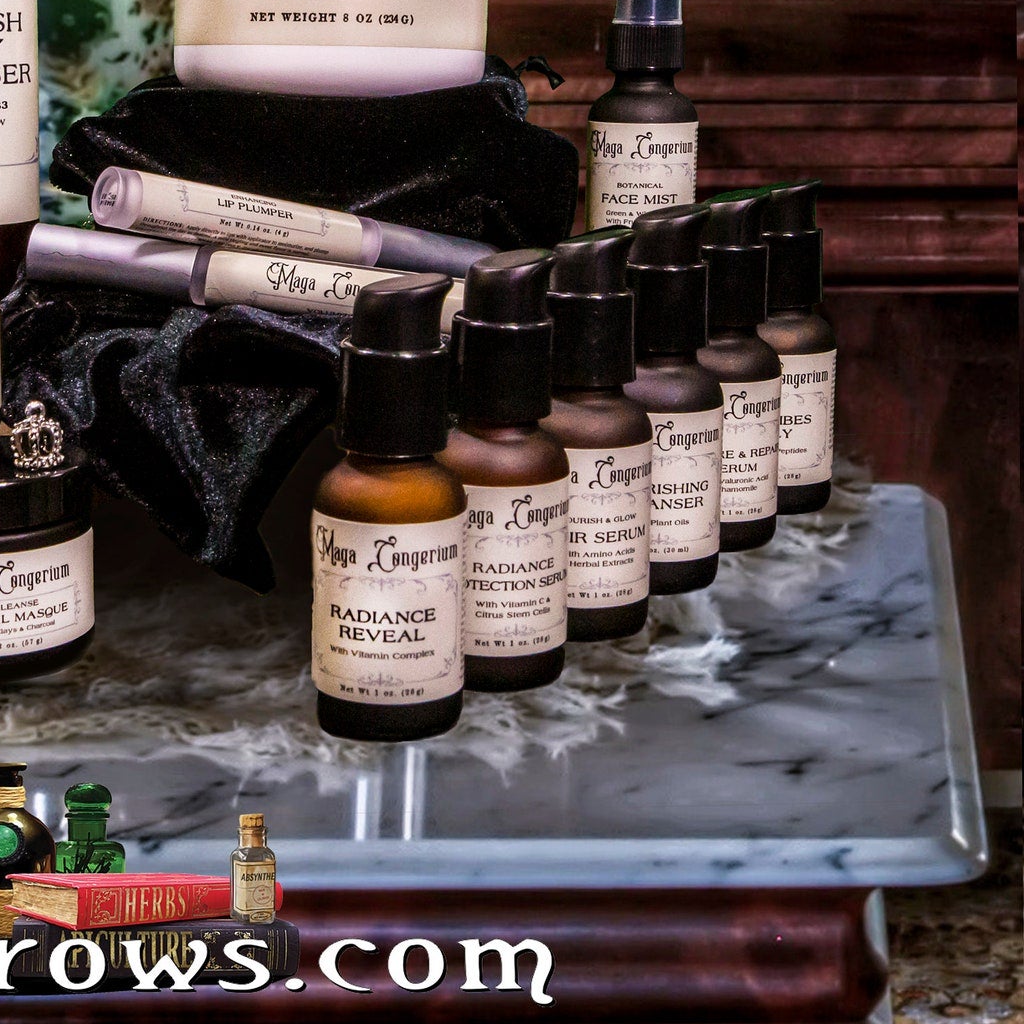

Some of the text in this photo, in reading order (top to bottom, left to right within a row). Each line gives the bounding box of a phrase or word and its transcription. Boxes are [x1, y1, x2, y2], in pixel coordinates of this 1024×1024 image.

[250, 12, 275, 22] NET
[281, 12, 336, 23] WEIGHT
[343, 14, 348, 22] 8
[356, 13, 372, 23] OZ
[591, 130, 623, 158] Maga
[601, 193, 678, 204] FACE MIST
[217, 198, 293, 219] LIP PLUMPER
[266, 262, 315, 294] Maga
[614, 513, 636, 522] GLOW
[594, 524, 645, 543] SERUM
[316, 526, 356, 568] Maga
[616, 547, 635, 555] Acids
[473, 558, 554, 574] RADIANCE
[603, 558, 633, 567] Extracts
[15, 602, 68, 622] MASQUE
[476, 600, 497, 609] With
[501, 599, 537, 608] Vitamin
[330, 604, 436, 624] RADIANCE
[26, 620, 55, 631] Charcoal
[339, 625, 425, 642] REVEAL
[330, 644, 435, 660] With Vitamin Complex
[241, 873, 275, 881] ABSYNTHE
[125, 886, 186, 923] HERBS
